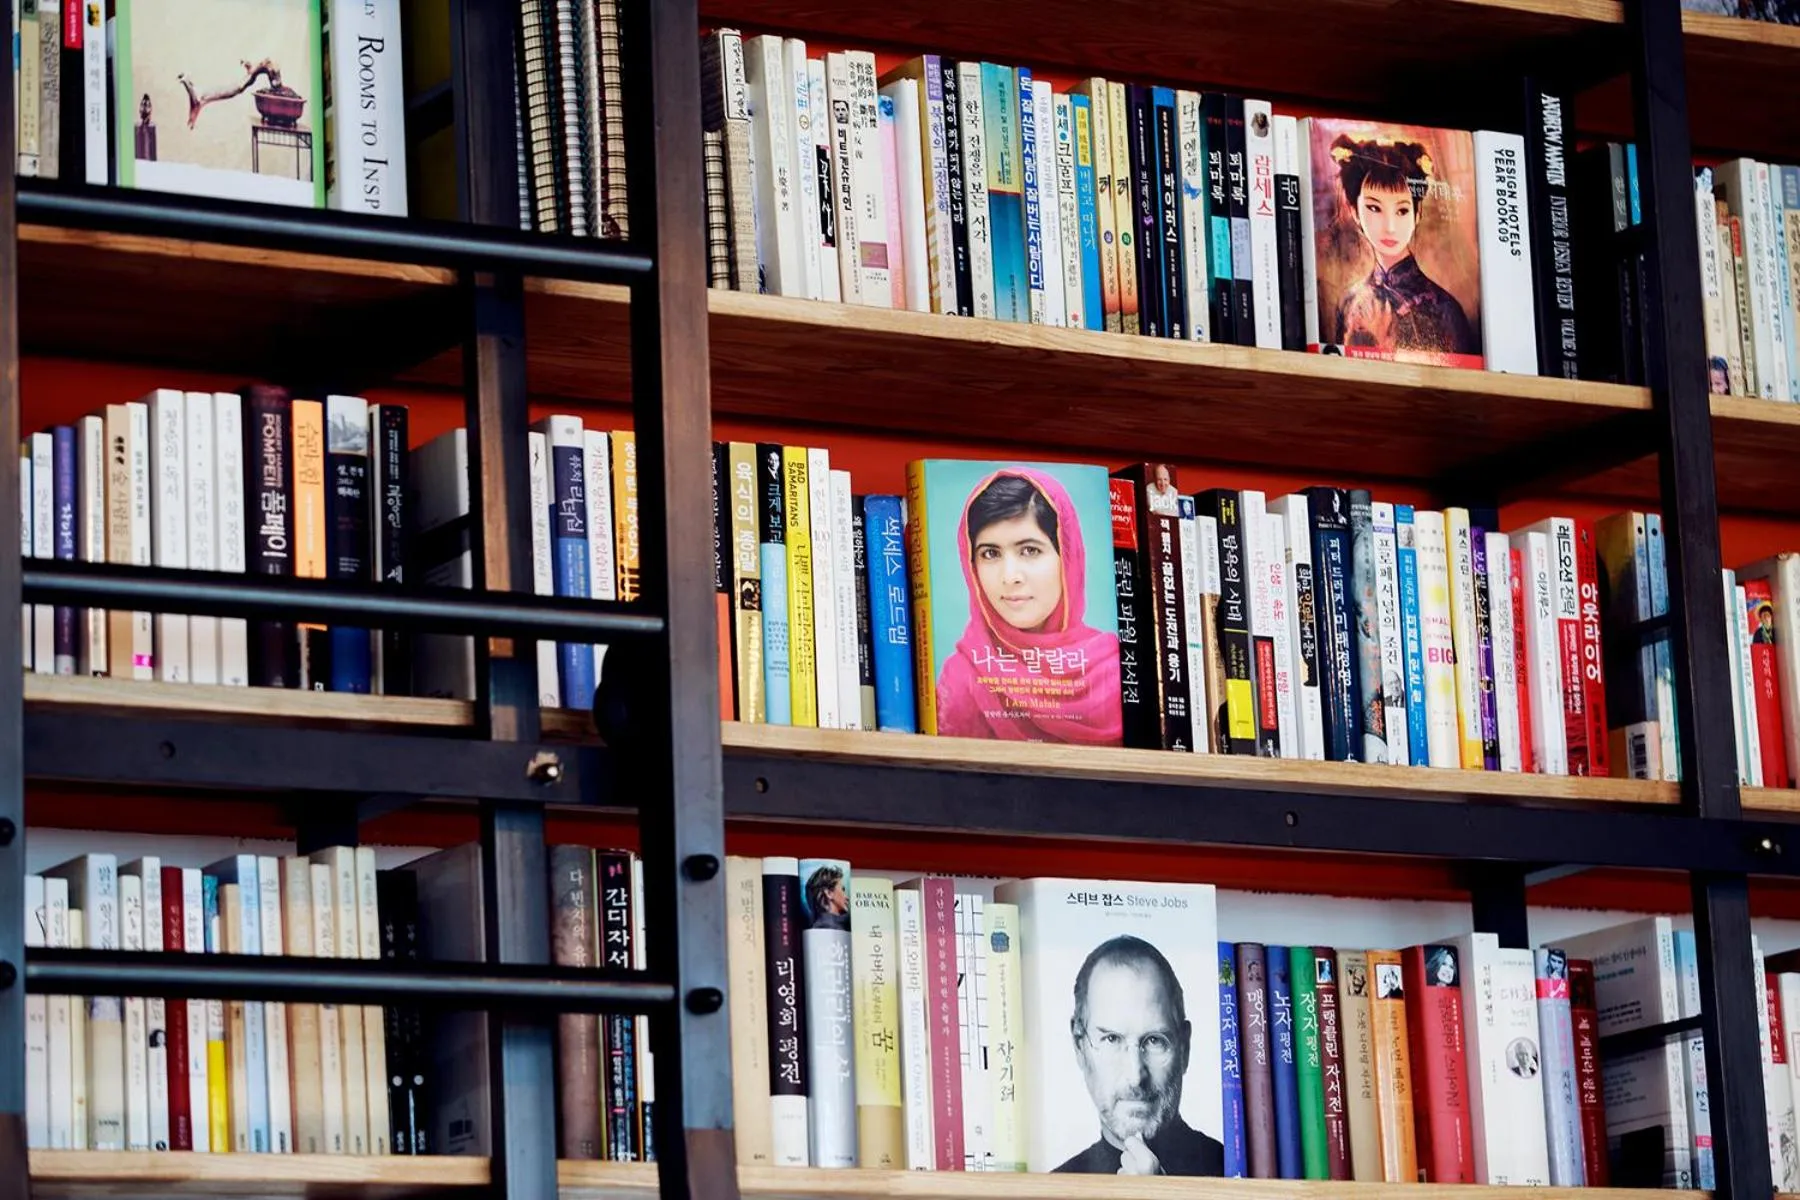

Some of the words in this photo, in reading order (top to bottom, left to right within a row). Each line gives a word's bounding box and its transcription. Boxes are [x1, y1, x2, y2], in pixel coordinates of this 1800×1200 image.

[362, 120, 377, 146] TO
[966, 100, 980, 128] 한국
[1541, 93, 1564, 143] ANDREW
[1495, 148, 1507, 183] YEAR
[1505, 149, 1518, 201] DESIGN
[1545, 144, 1566, 187] MARTIN
[1253, 156, 1274, 217] 람세스
[953, 203, 964, 224] 나라
[972, 215, 987, 244] 시각
[1508, 205, 1522, 256] HOTELS
[1549, 195, 1568, 237] INTERIOR
[1553, 240, 1571, 273] DESIGN
[1555, 276, 1574, 310] REVIEW
[262, 412, 277, 486] POMPEII
[569, 454, 582, 483] 퓨처
[797, 463, 806, 484] BAD
[558, 486, 584, 533] 리더십
[788, 461, 799, 528] SAMARITANS
[260, 490, 287, 558] 폼페이
[1221, 535, 1240, 583] 탐욕의
[1556, 524, 1574, 583] 레드오션
[1114, 557, 1134, 597] 콜린
[1536, 571, 1550, 620] 이카루스
[887, 583, 909, 645] 로드맵
[1225, 587, 1243, 621] 시대
[1559, 585, 1575, 617] 전략
[1117, 603, 1138, 643] 파월
[1580, 582, 1602, 685] 아웃라이어
[972, 645, 1019, 673] 나는
[1022, 646, 1089, 677] 말랄라
[1427, 646, 1454, 666] BIG
[1121, 650, 1140, 705] 자서전
[854, 890, 890, 900] BARACK
[854, 898, 890, 910] OBAMA
[1066, 892, 1100, 906] 스티브
[1102, 893, 1125, 907] 잡스
[1126, 893, 1158, 908] Steve
[1160, 894, 1189, 910] Jobs
[869, 924, 882, 938] 내
[906, 950, 920, 993] 오바마
[777, 956, 801, 1034] 리영희
[816, 941, 847, 1049] 힐러리의
[1221, 993, 1237, 1037] 공자
[1247, 989, 1267, 1030] 맹자
[1273, 990, 1292, 1028] 노자
[1300, 991, 1319, 1033] 장자
[871, 1026, 894, 1054] 꿈
[1322, 993, 1340, 1058] 프랭클린
[779, 1036, 802, 1085] 평전
[1223, 1039, 1239, 1080] 평전
[1252, 1033, 1268, 1067] 평전
[1278, 1032, 1294, 1066] 평전
[1304, 1035, 1320, 1069] 평전
[997, 1039, 1016, 1103] 장기려
[1325, 1063, 1343, 1115] 자서전
[1362, 1067, 1372, 1099] 자서전
